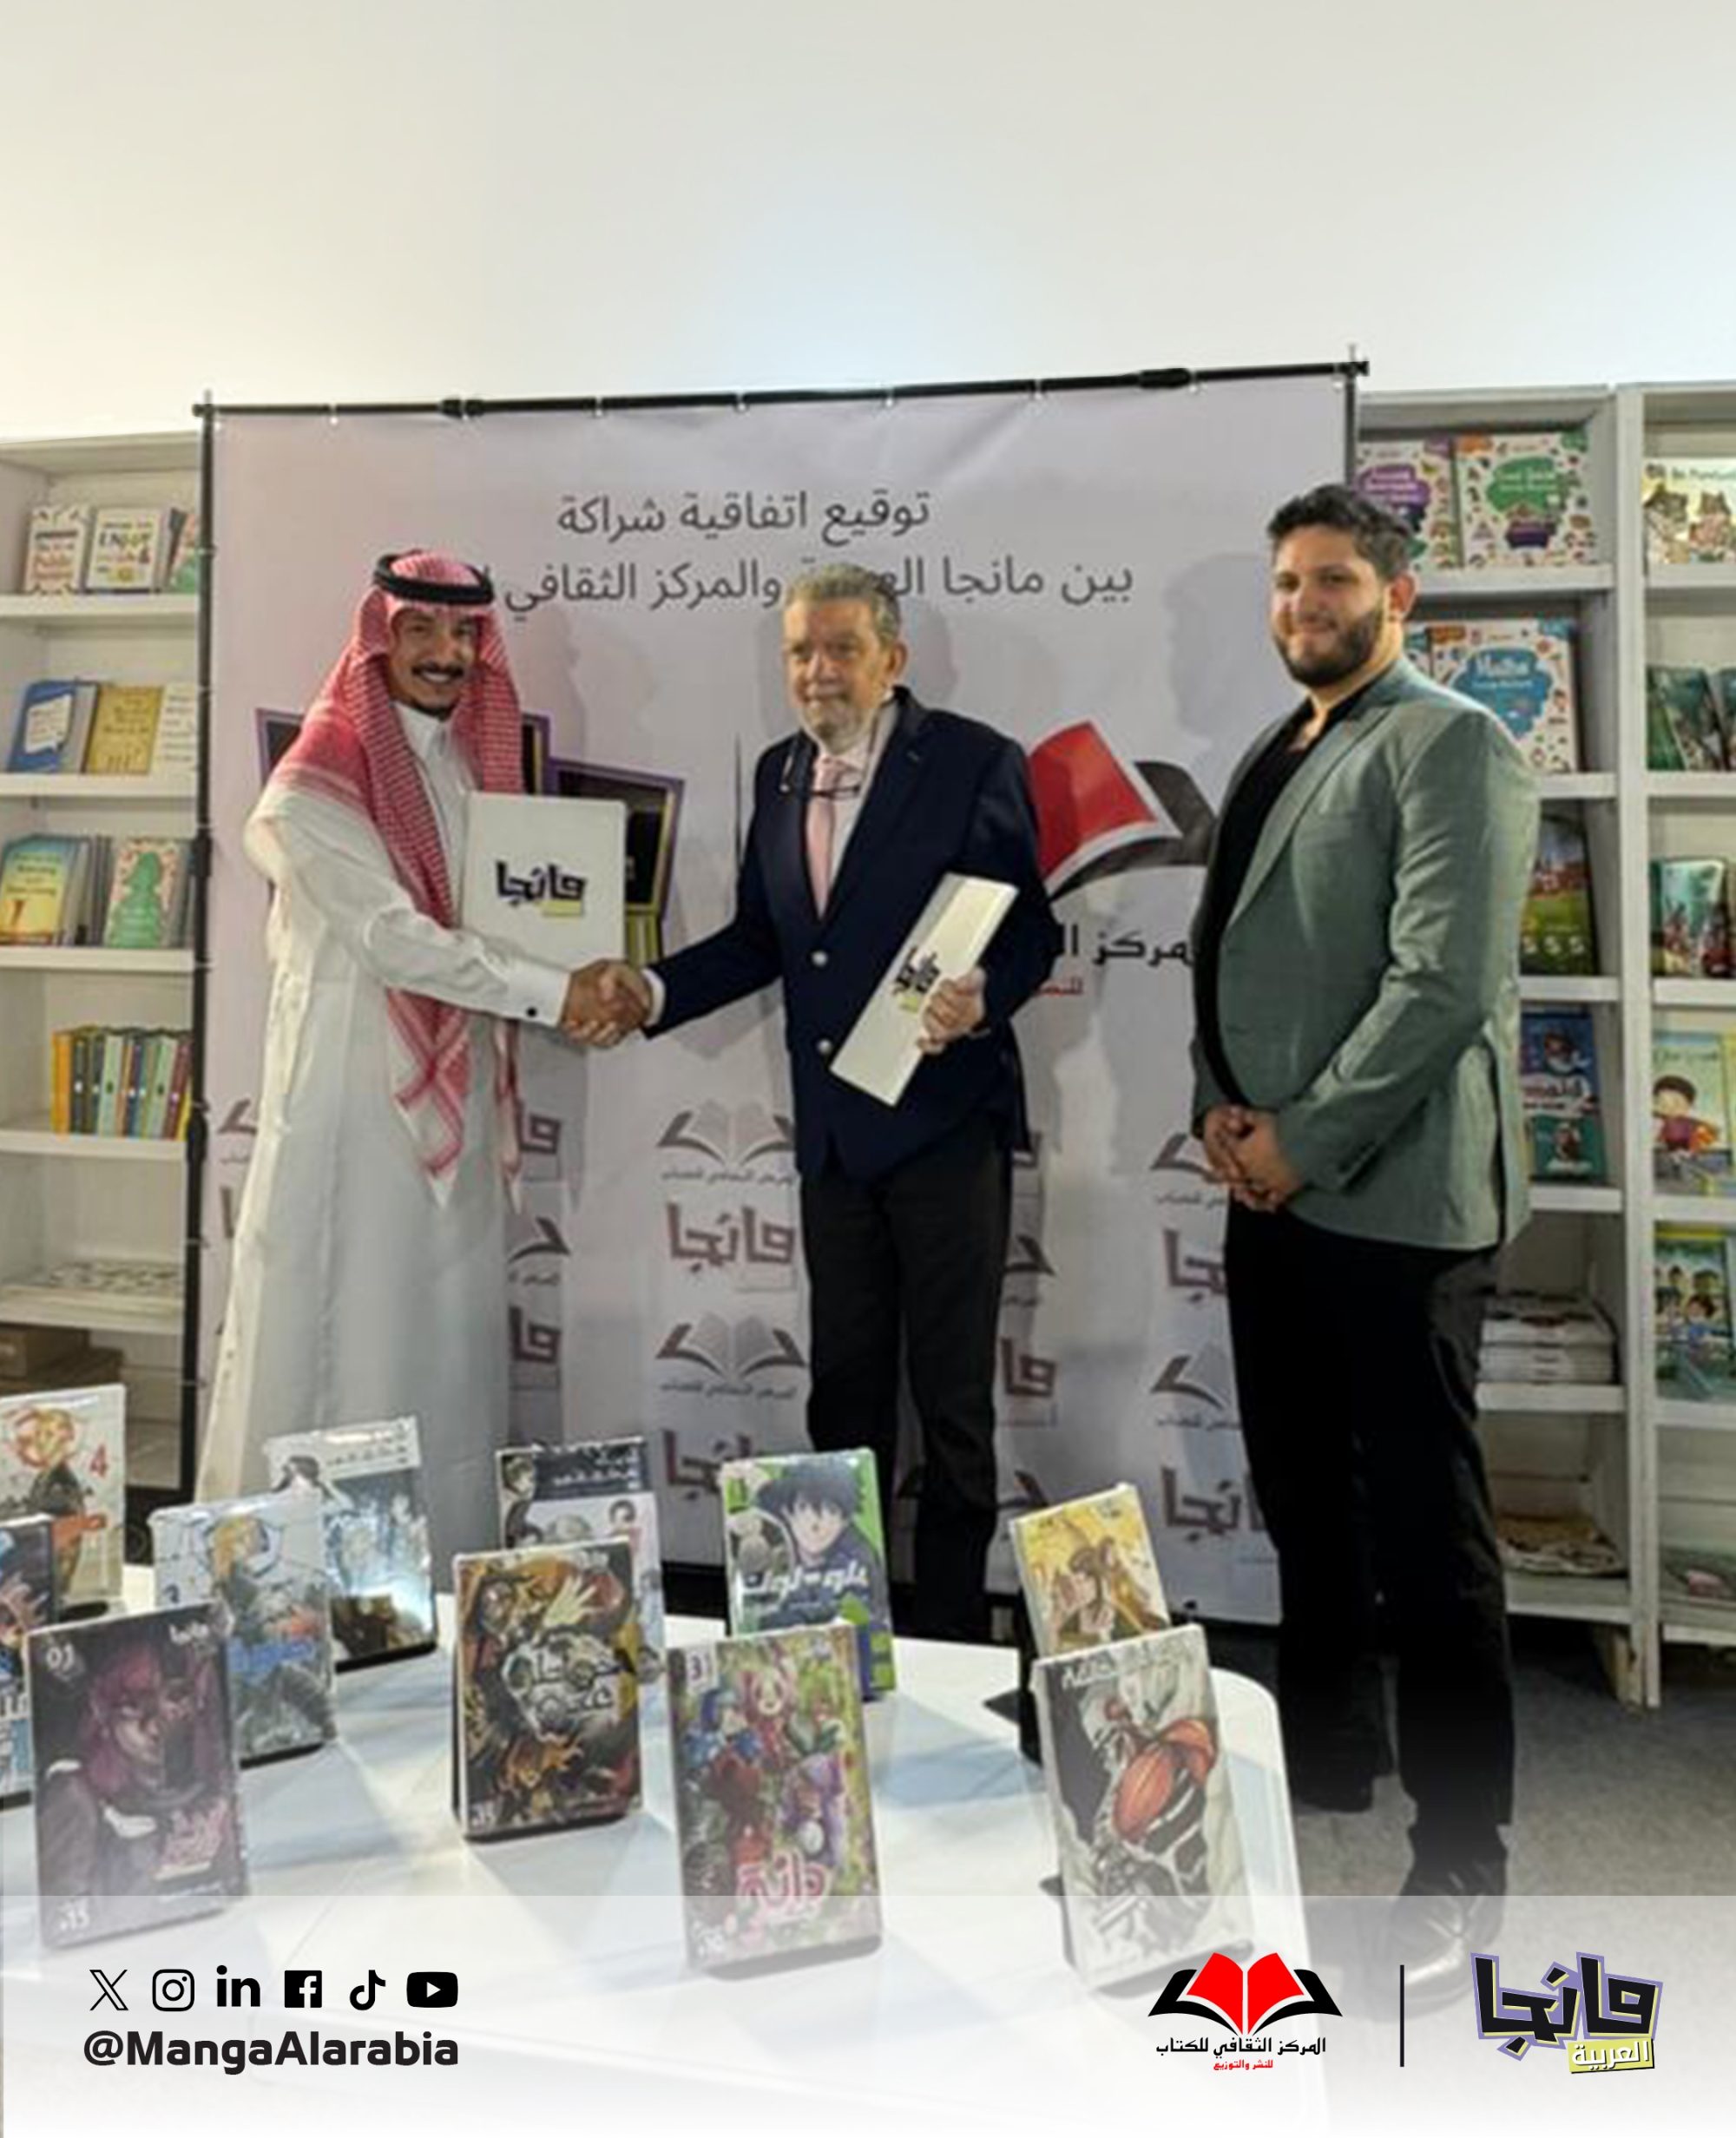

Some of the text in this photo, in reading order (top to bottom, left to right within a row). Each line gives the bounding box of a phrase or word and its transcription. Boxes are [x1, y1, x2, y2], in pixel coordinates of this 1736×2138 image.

[557, 489, 930, 547] توقيع اتفاقية شراكة
[504, 562, 636, 622] الثقافي
[649, 558, 782, 609] والمركز
[943, 555, 1043, 603] مانجا
[1061, 566, 1132, 605] بين
[667, 1201, 795, 1274] مانجا
[89, 1444, 108, 1478] 4
